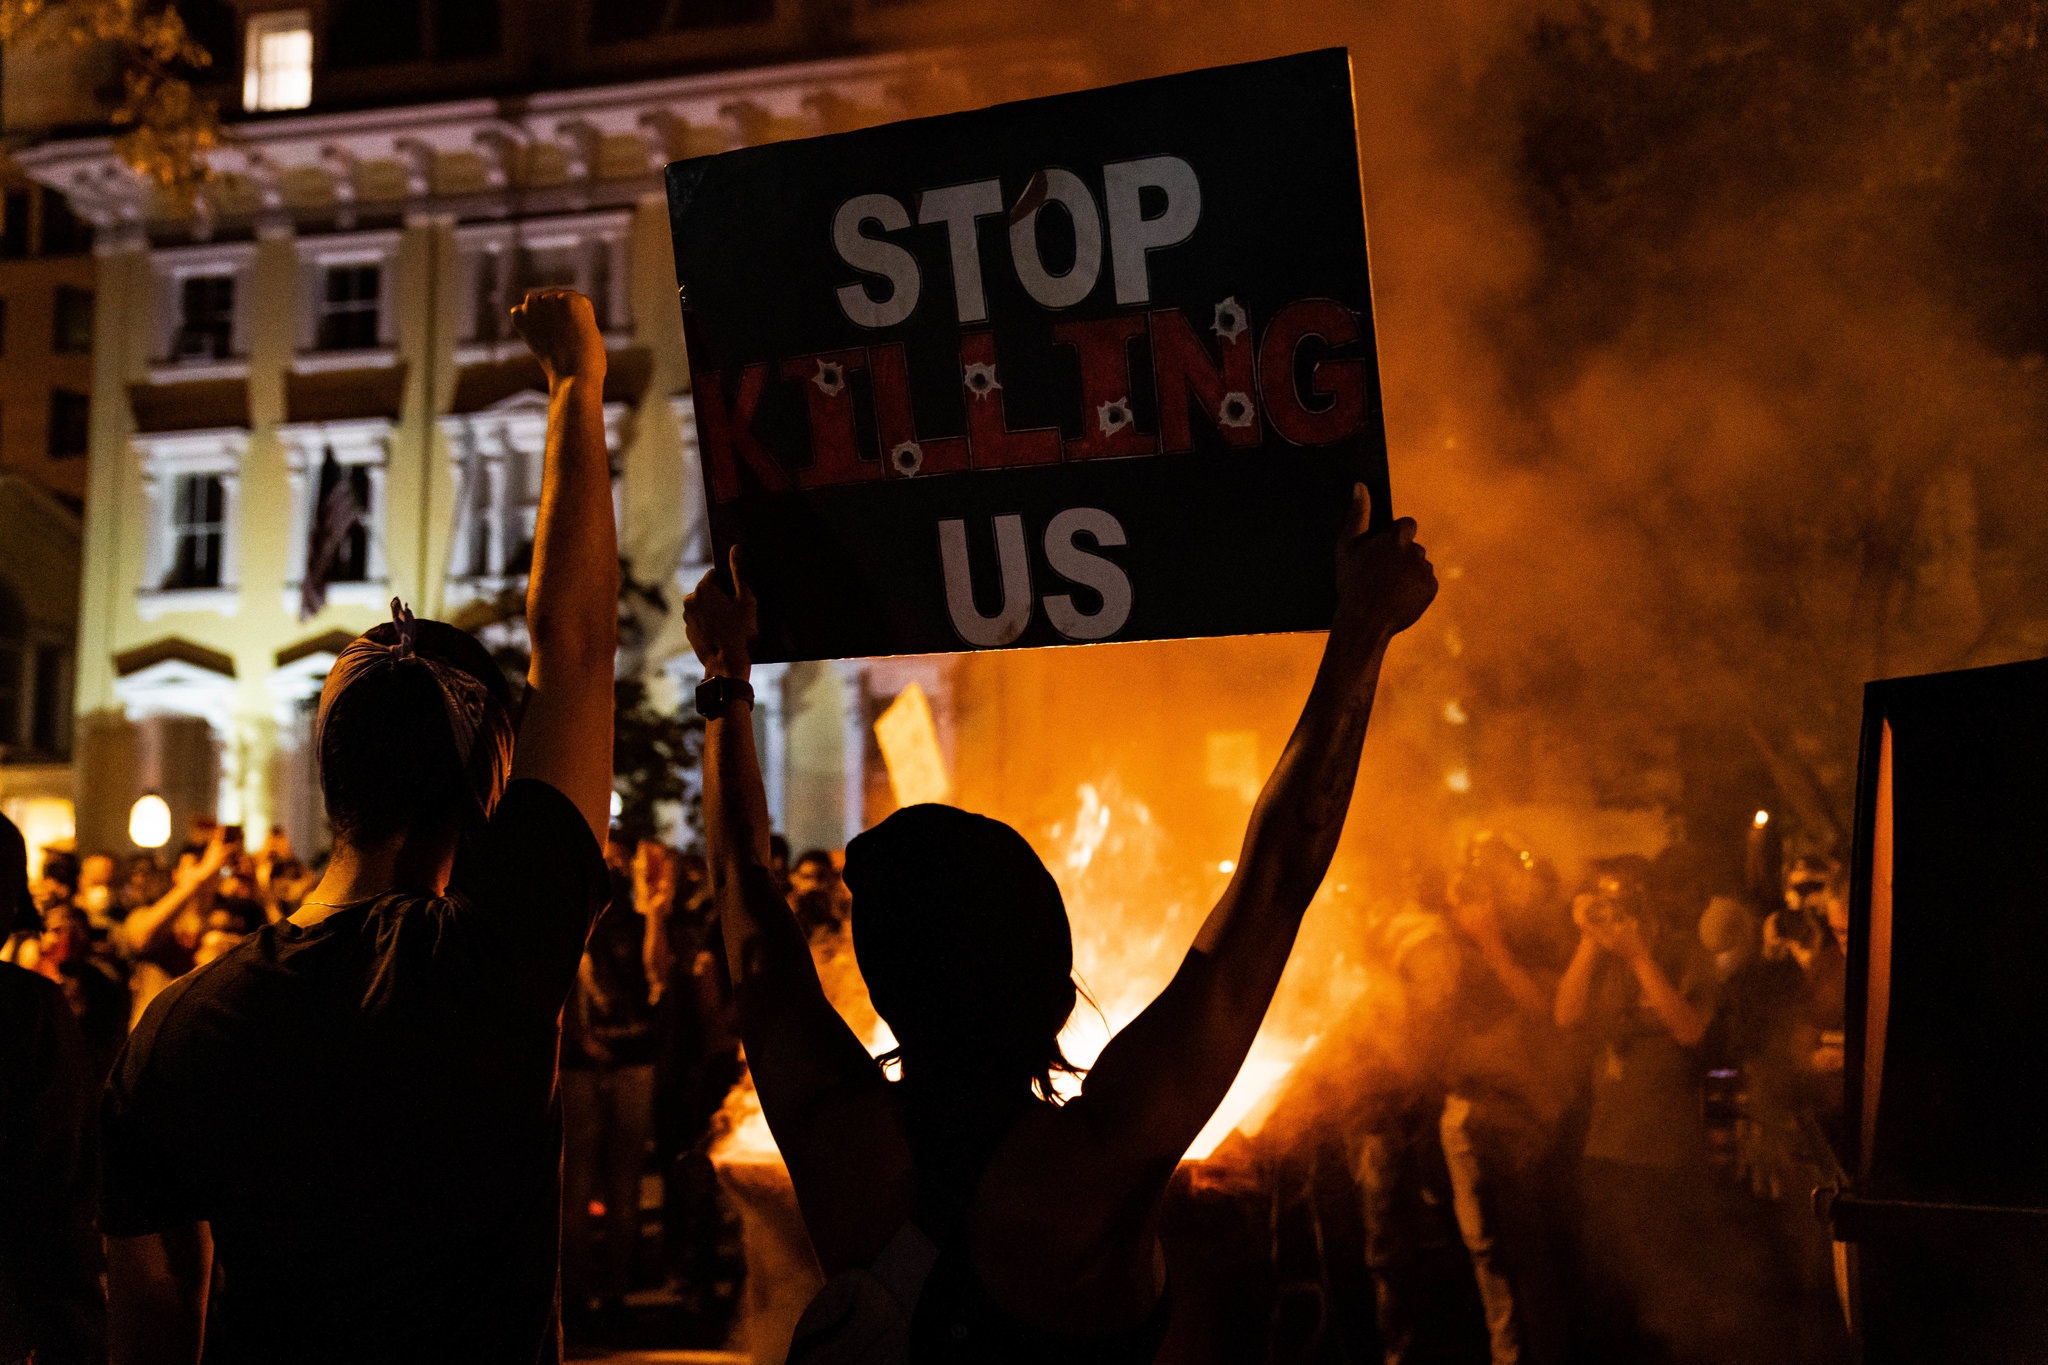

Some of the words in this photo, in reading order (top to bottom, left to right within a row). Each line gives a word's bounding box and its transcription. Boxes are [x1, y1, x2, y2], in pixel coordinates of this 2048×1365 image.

[831, 155, 1202, 329] STOP
[695, 297, 1367, 501] KILLING
[938, 507, 1133, 647] US
